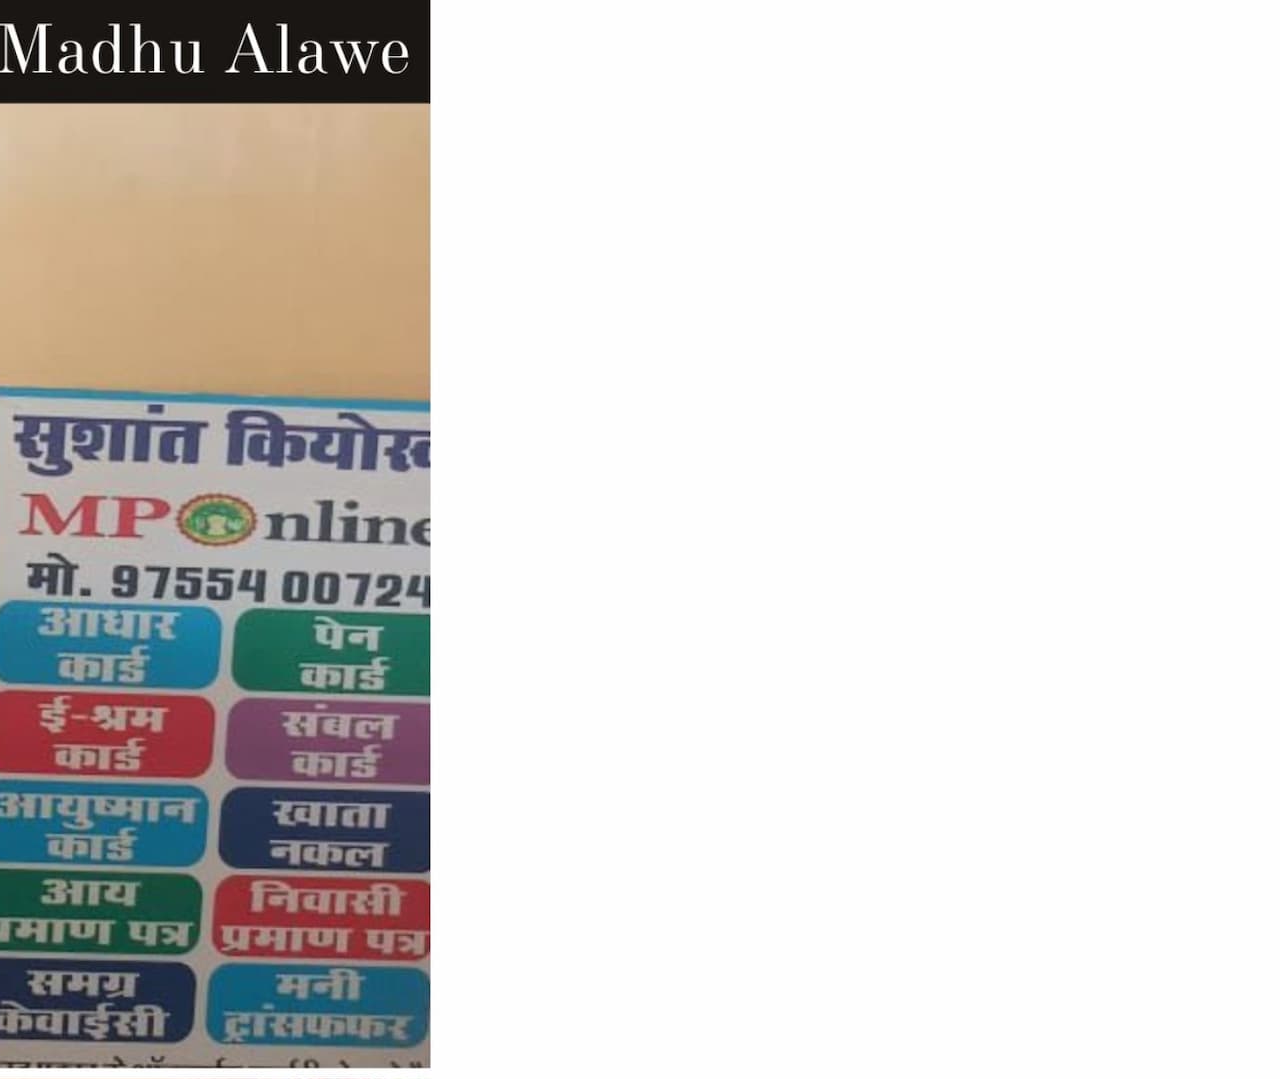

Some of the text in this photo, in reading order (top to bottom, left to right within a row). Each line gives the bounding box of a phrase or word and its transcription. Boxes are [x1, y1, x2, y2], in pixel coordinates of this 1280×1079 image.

[13, 403, 209, 477] सुशांत
[18, 493, 171, 539] MP
[26, 552, 430, 609] मो. 97554 00724
[37, 605, 182, 640] आधार
[312, 616, 385, 653] पेन
[57, 644, 150, 684] कार्ड
[299, 656, 391, 692] कार्ड
[38, 695, 170, 733] ई-श्रम
[282, 703, 401, 741] संबल
[54, 738, 148, 772] कार्ड
[291, 744, 383, 779] कार्ड
[273, 799, 393, 830] खाता
[45, 827, 138, 862] कार्ड
[270, 840, 391, 869] नकल
[40, 877, 142, 908] आय
[250, 879, 407, 917] निवासी
[127, 920, 195, 949] पत्र
[220, 924, 429, 956] प्रमाण पत्र
[27, 969, 141, 1001] समग्र
[275, 967, 366, 1001] मनी
